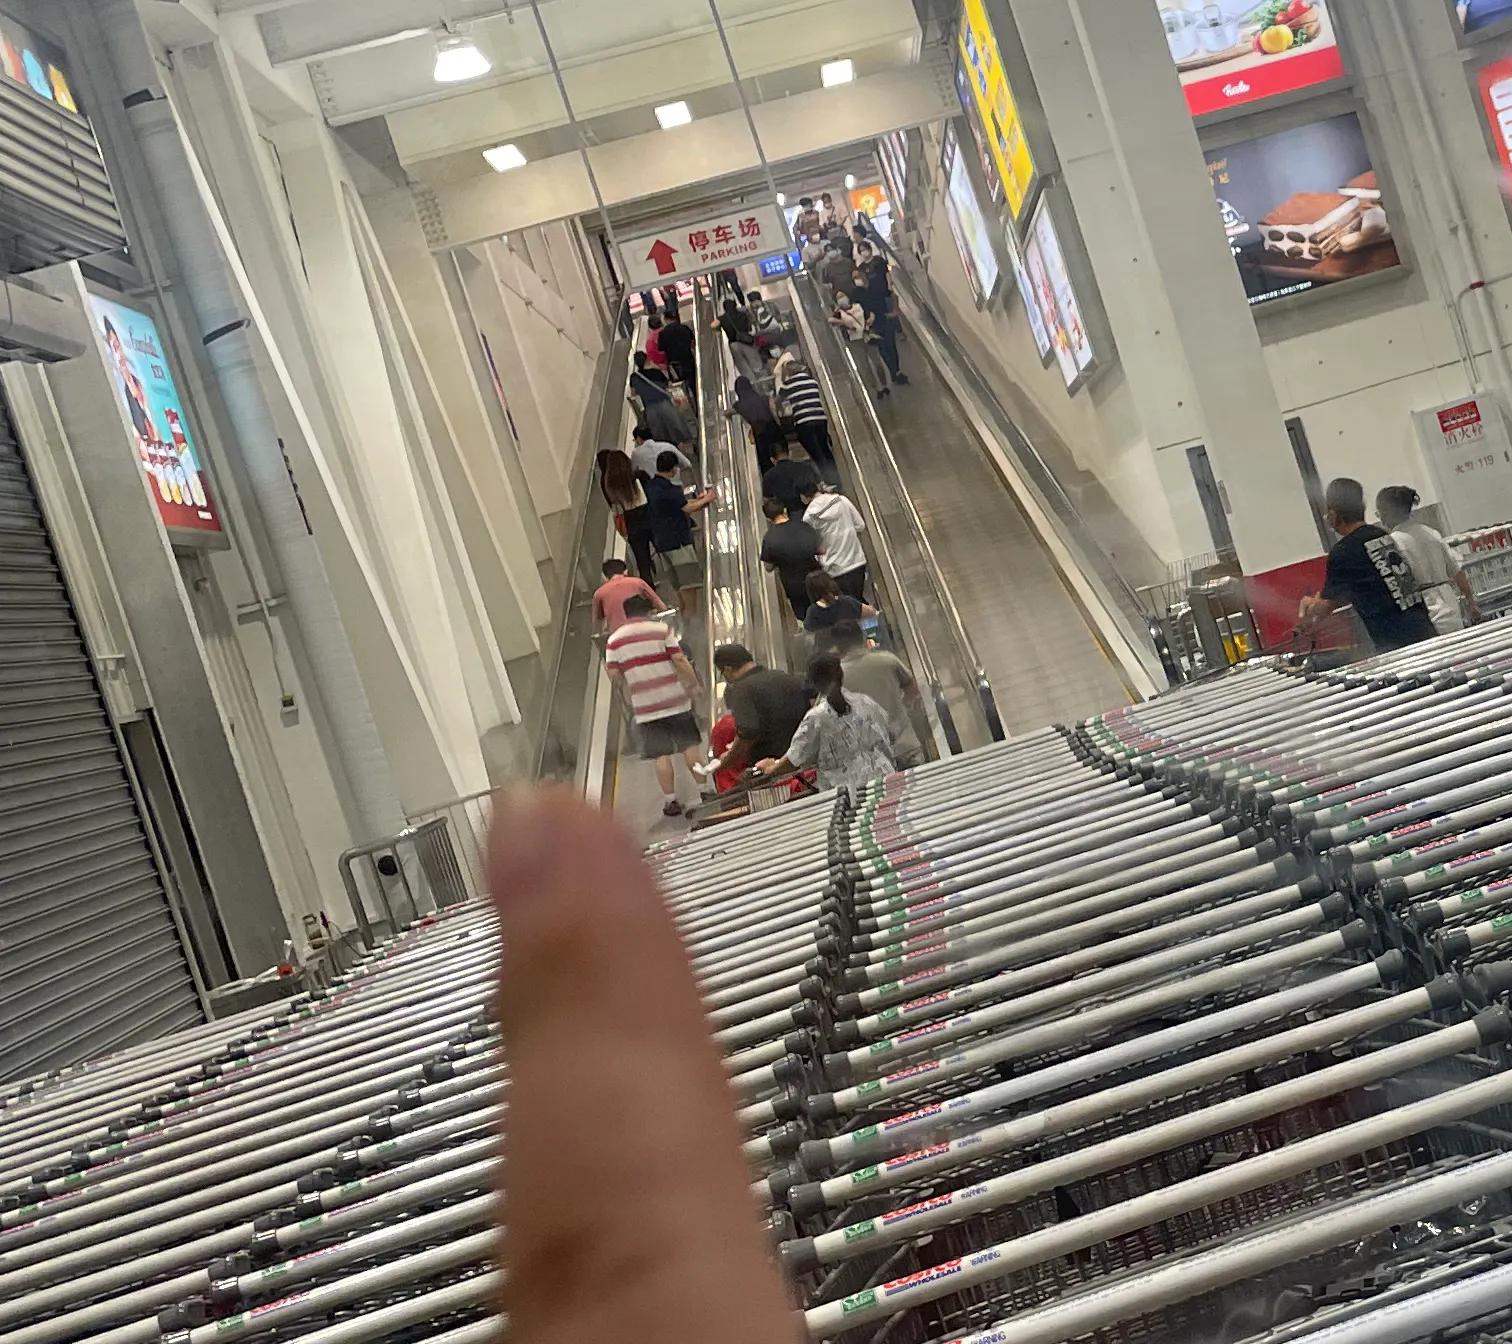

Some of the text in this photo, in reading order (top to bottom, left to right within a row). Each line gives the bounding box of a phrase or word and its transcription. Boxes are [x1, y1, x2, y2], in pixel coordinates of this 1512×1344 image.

[687, 216, 762, 253] 停车场
[700, 241, 759, 264] PARKING
